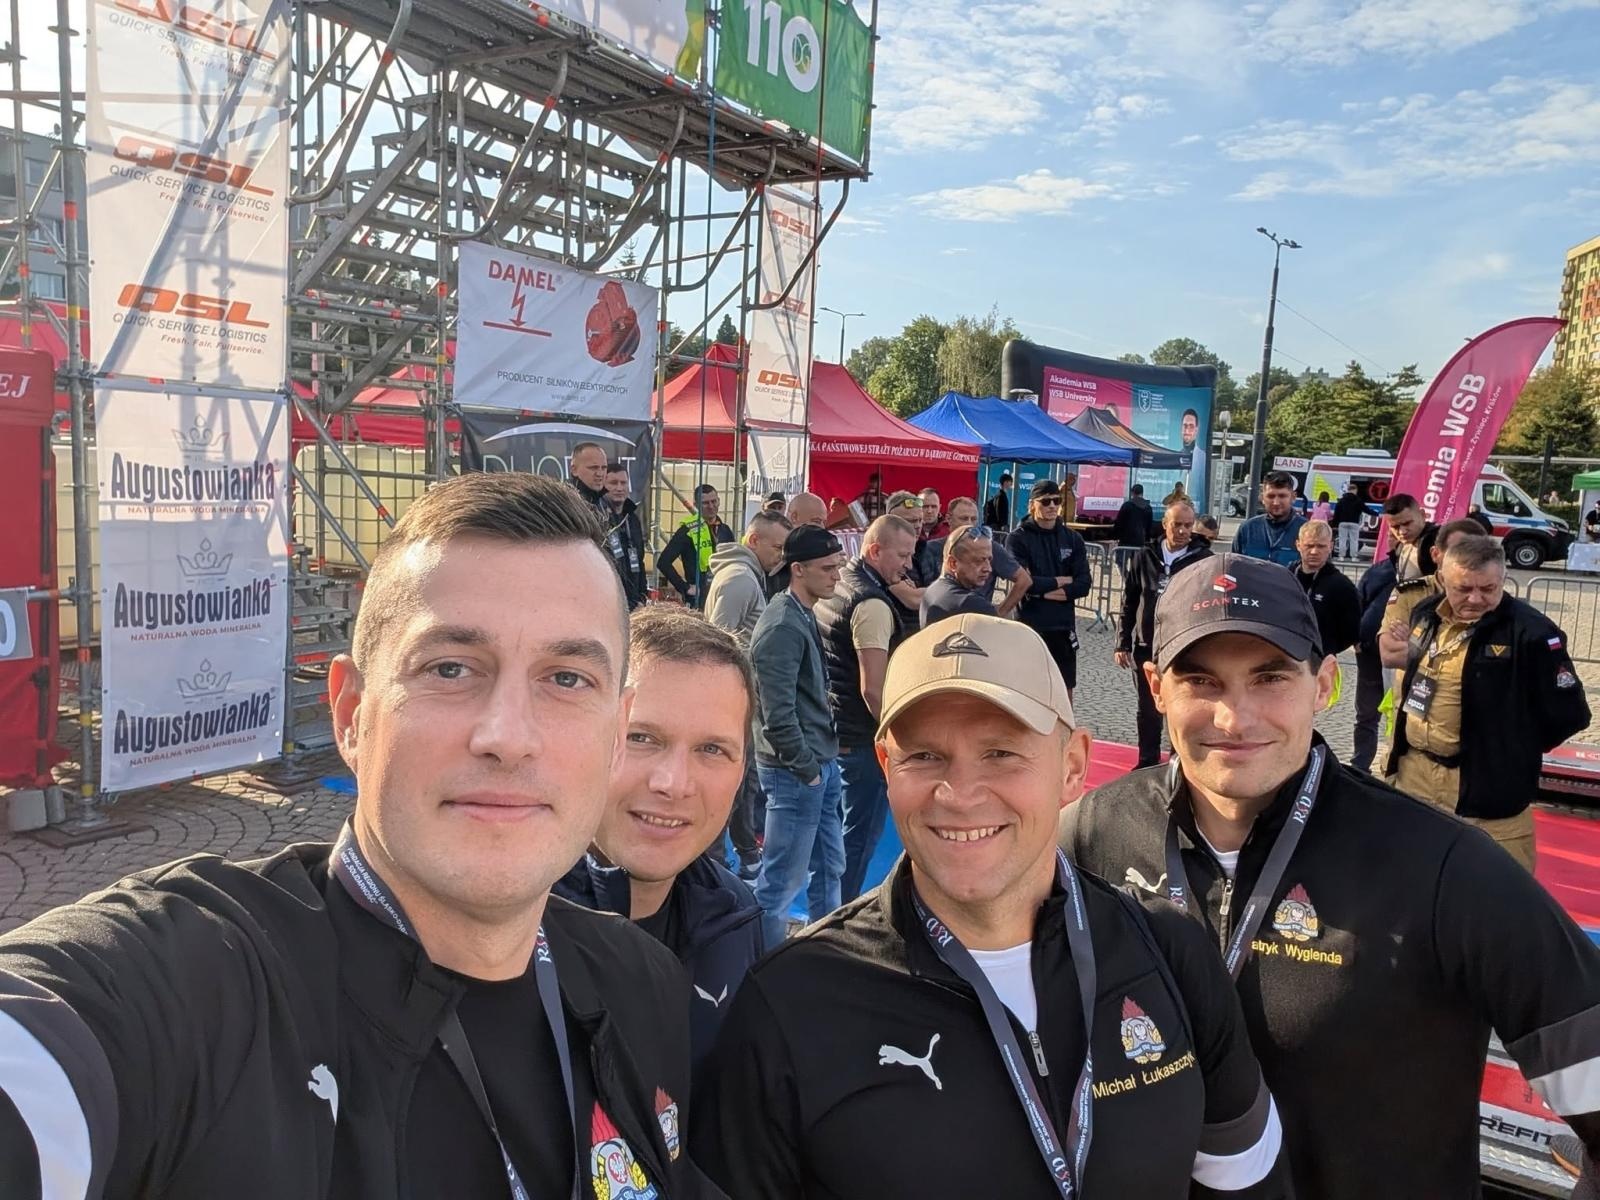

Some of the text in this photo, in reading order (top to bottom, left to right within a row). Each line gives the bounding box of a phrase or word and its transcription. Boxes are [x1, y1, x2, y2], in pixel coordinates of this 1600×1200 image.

[108, 12, 152, 33] QUICK
[744, 0, 820, 93] 110
[113, 135, 274, 196] QSL
[109, 164, 271, 212] QUICK SERVICE LOGISTICS
[488, 260, 556, 292] DAMEL
[117, 283, 269, 328] QSL
[113, 312, 267, 343] QUICK SERVICE LOGISTICS
[497, 370, 543, 385] PRODUCENT
[1049, 374, 1097, 390] Akademia WSB
[1049, 388, 1097, 405] WSB University
[1440, 374, 1485, 436] WSB
[821, 440, 868, 454] PAŃSTWOWEJ
[868, 443, 892, 455] STRAŻY
[891, 444, 920, 457] POŻARNEJ
[1274, 457, 1305, 469] LANS
[111, 453, 275, 503] Augustowianka
[128, 506, 267, 514] NATURALNA WODA MINERALNA
[114, 577, 271, 630] Augustowianka
[130, 622, 261, 642] NATURALNA WODA MINERALNA
[114, 692, 271, 754] Augustowianka
[129, 734, 257, 767] NATURALNA WODA MINERALNA
[1251, 940, 1342, 965] atryk Wyglenda
[1092, 1074, 1137, 1099] Michał
[1142, 1050, 1195, 1085] Łukaszczyk
